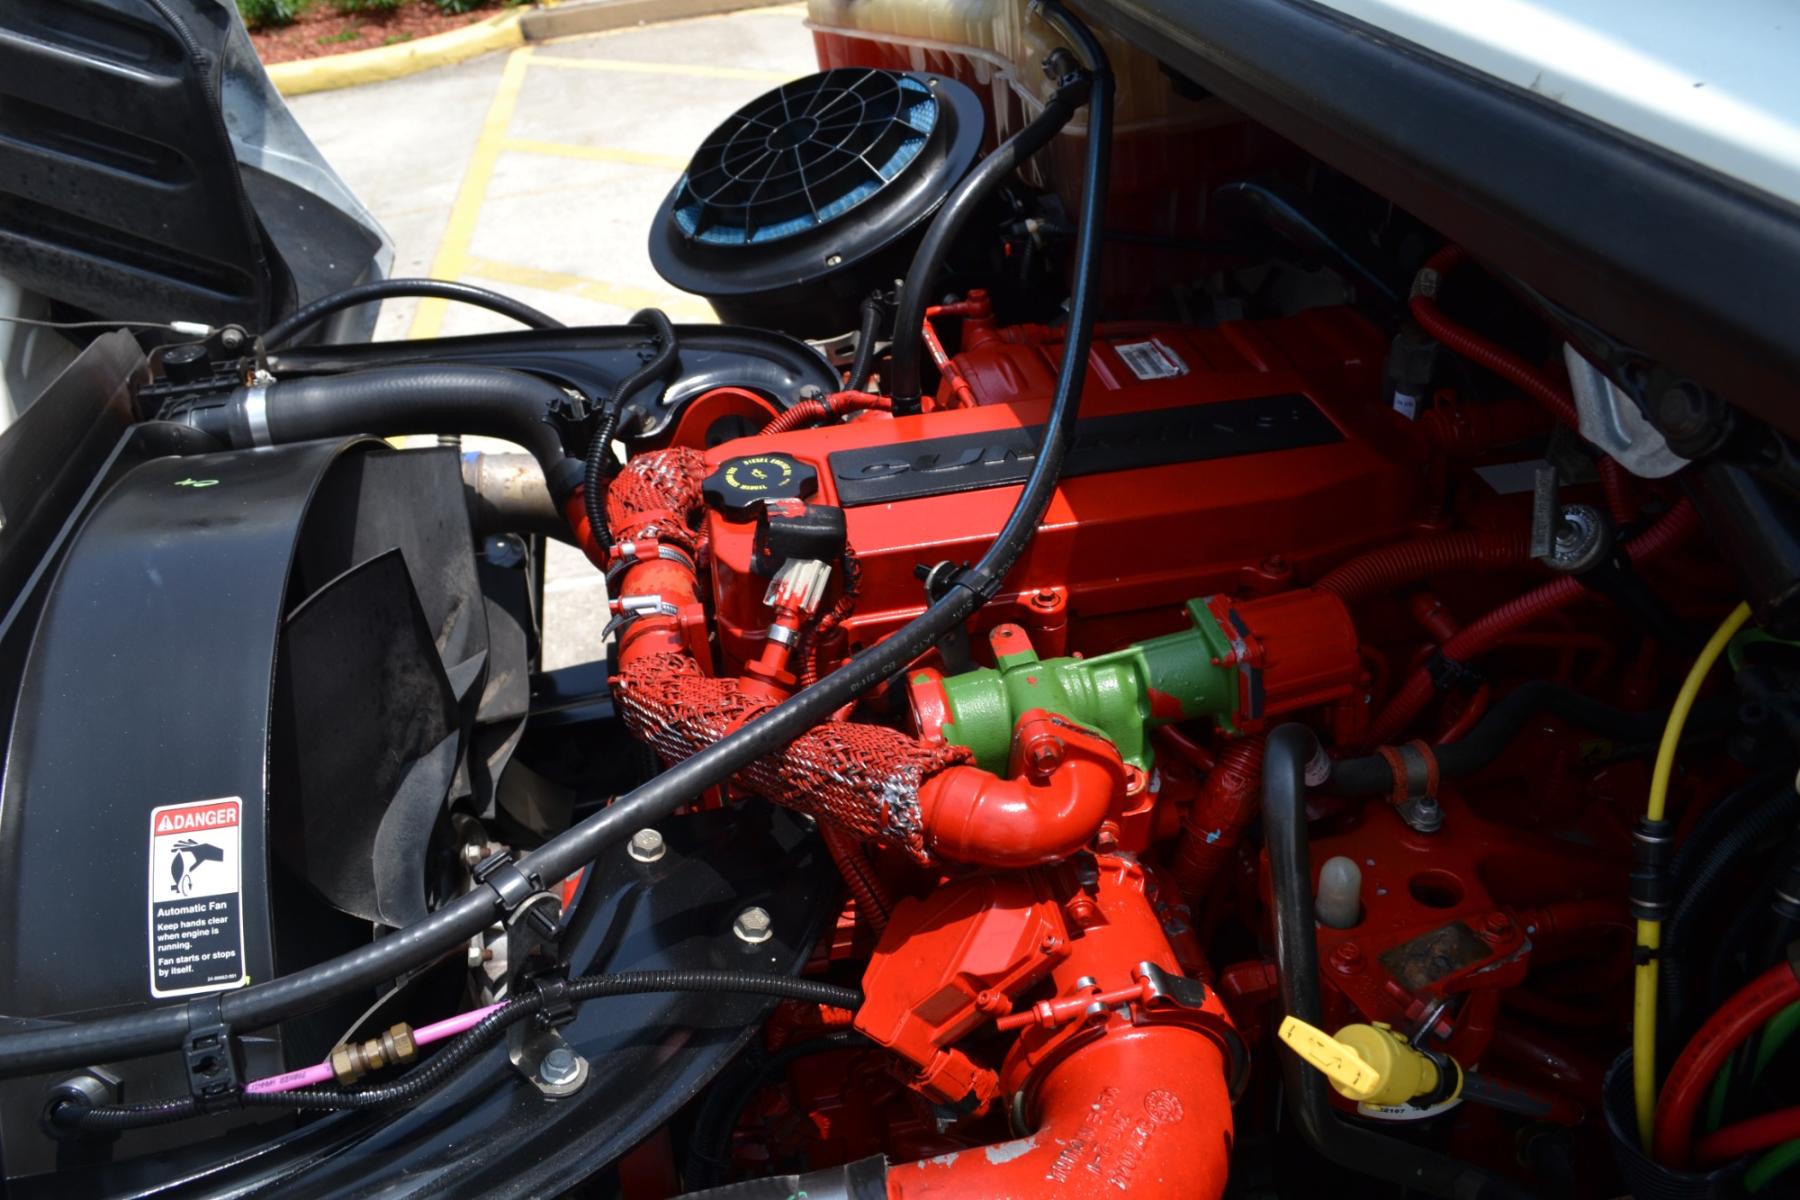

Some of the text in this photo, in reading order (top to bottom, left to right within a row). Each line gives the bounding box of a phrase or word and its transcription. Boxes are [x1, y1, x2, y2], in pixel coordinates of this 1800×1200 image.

[173, 809, 237, 829] DANGER
[157, 902, 227, 917] Automatic Fan
[157, 916, 229, 932] Keep hands clear
[157, 928, 219, 941] when engine is
[158, 942, 193, 952] running.
[158, 950, 236, 966] Fan starts or stops
[159, 965, 194, 978] by itself.
